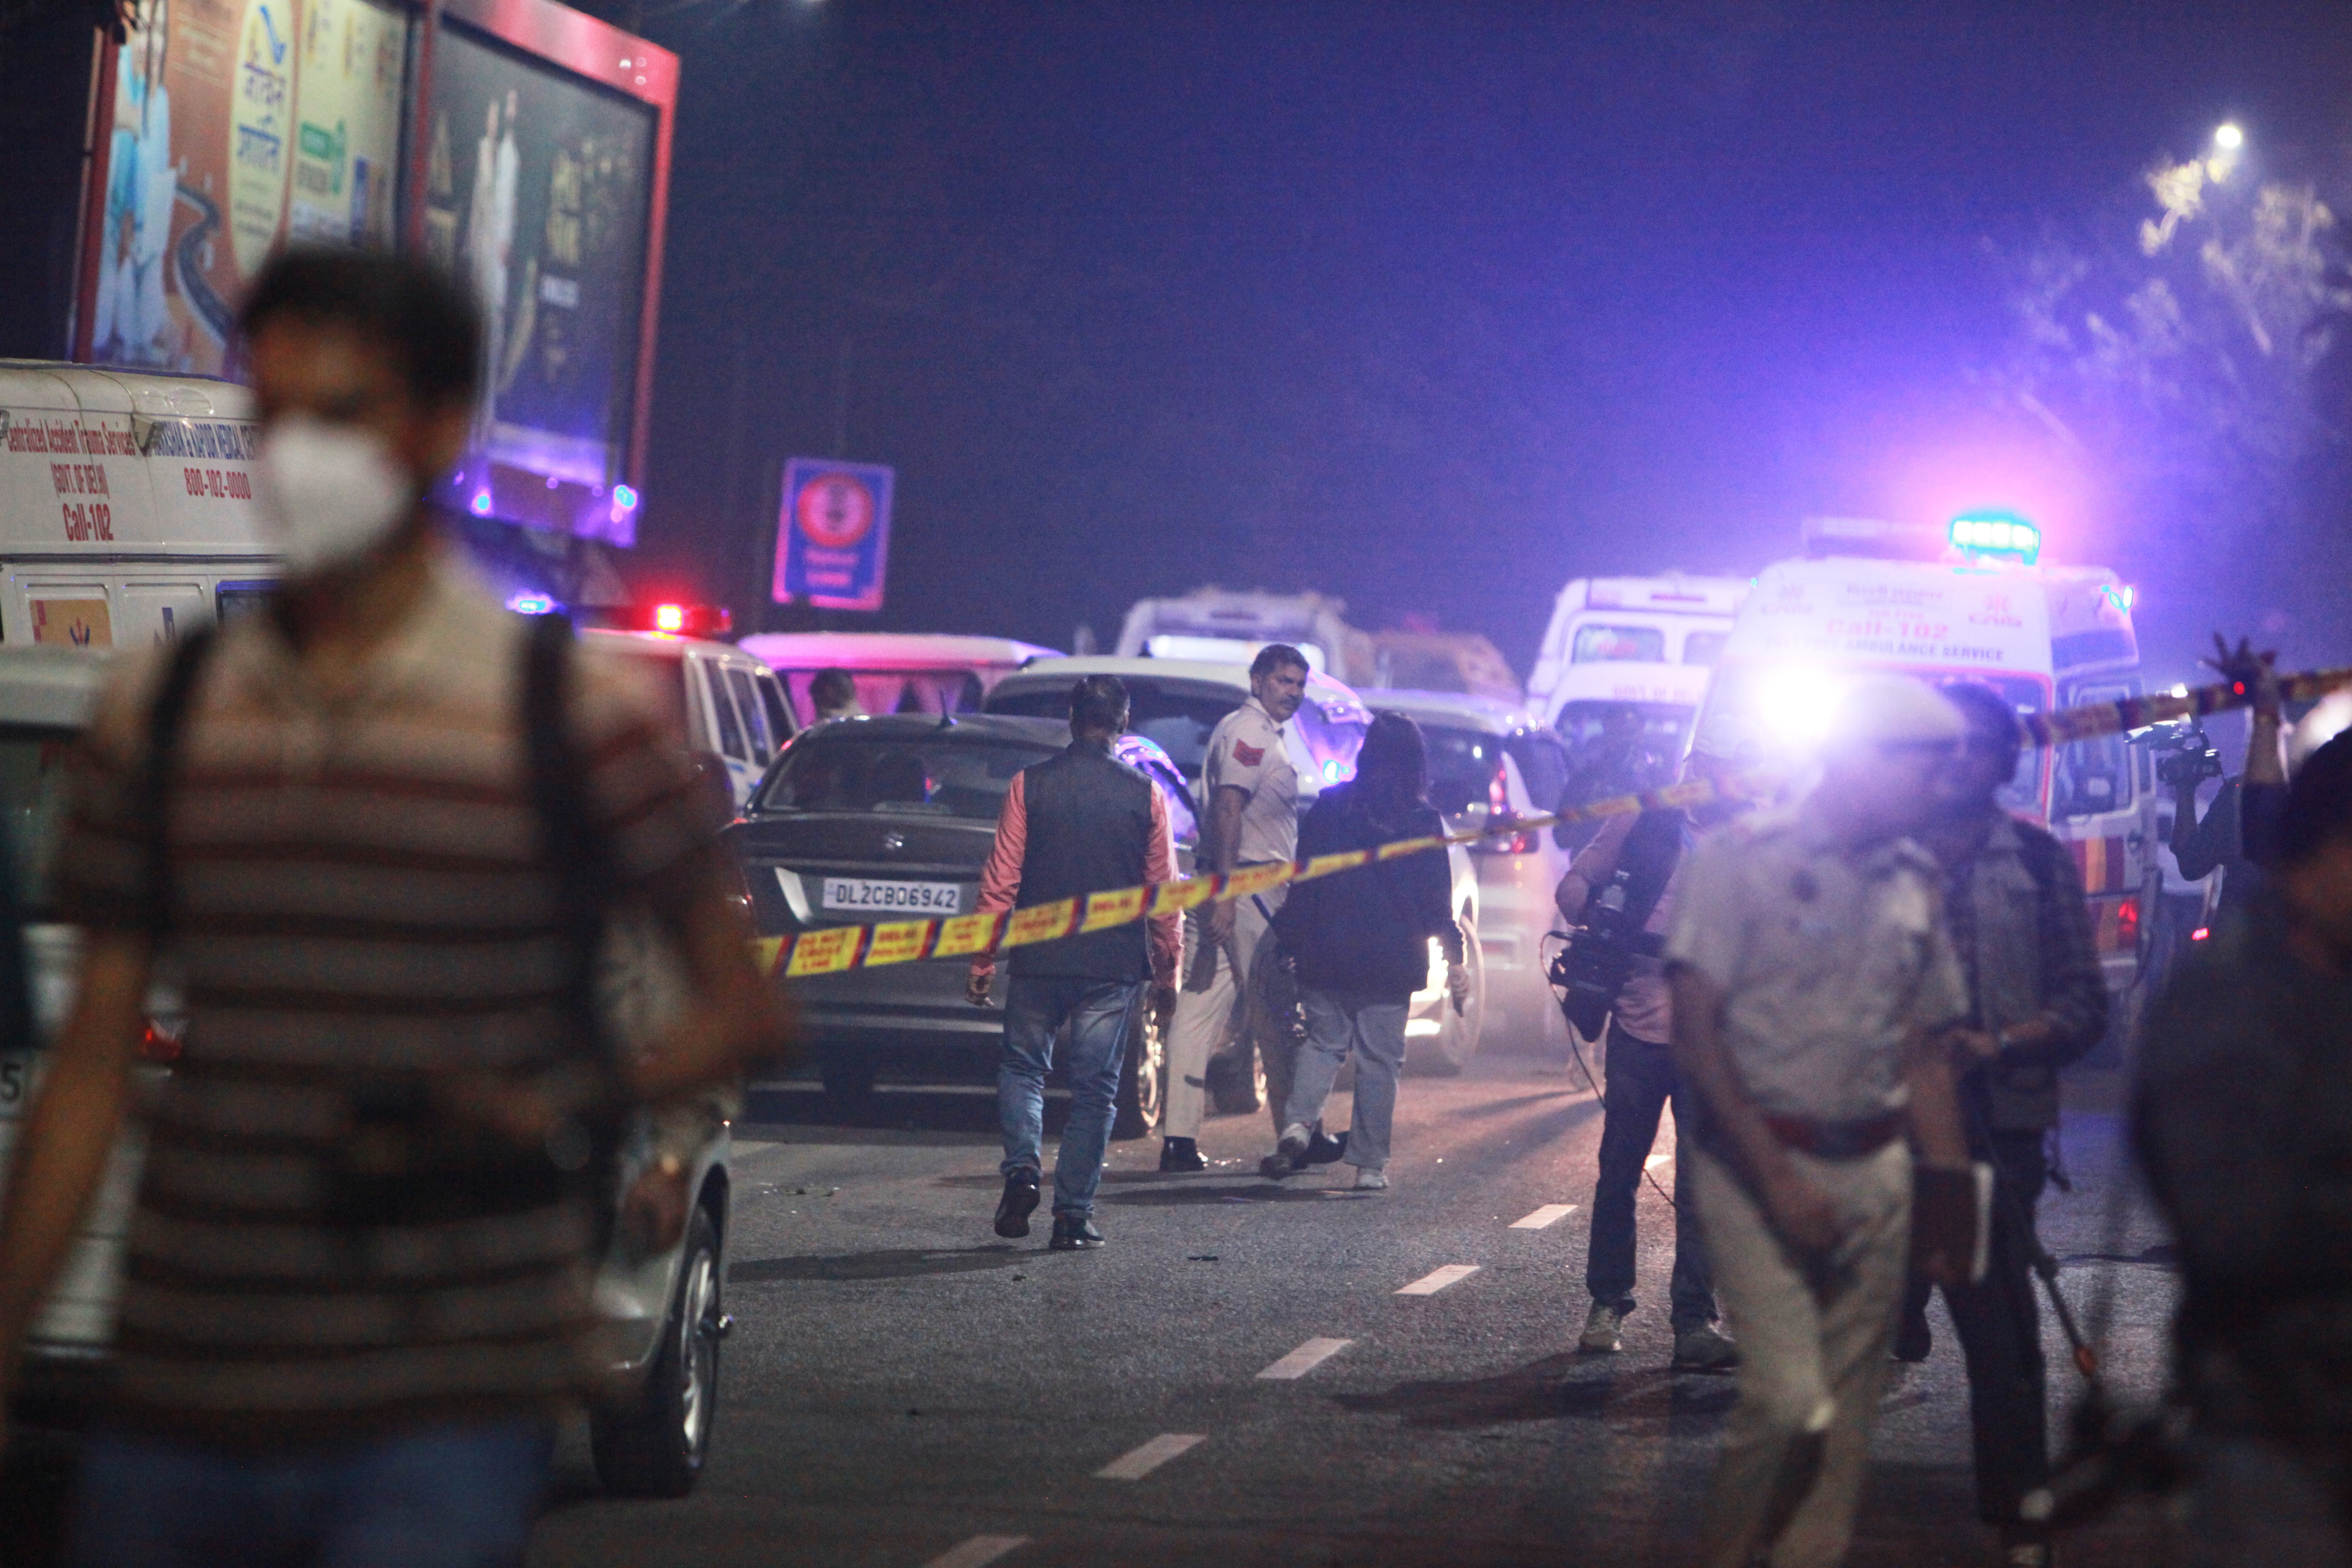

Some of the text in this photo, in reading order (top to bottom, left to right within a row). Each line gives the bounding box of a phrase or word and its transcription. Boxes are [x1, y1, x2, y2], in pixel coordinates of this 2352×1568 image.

[101, 421, 136, 455] Services
[74, 464, 85, 493] OF
[63, 503, 113, 541] Call-102
[1828, 618, 1949, 640] Call-102
[1844, 639, 1937, 656] AMBULANCE
[1943, 645, 2004, 661] SERVICE
